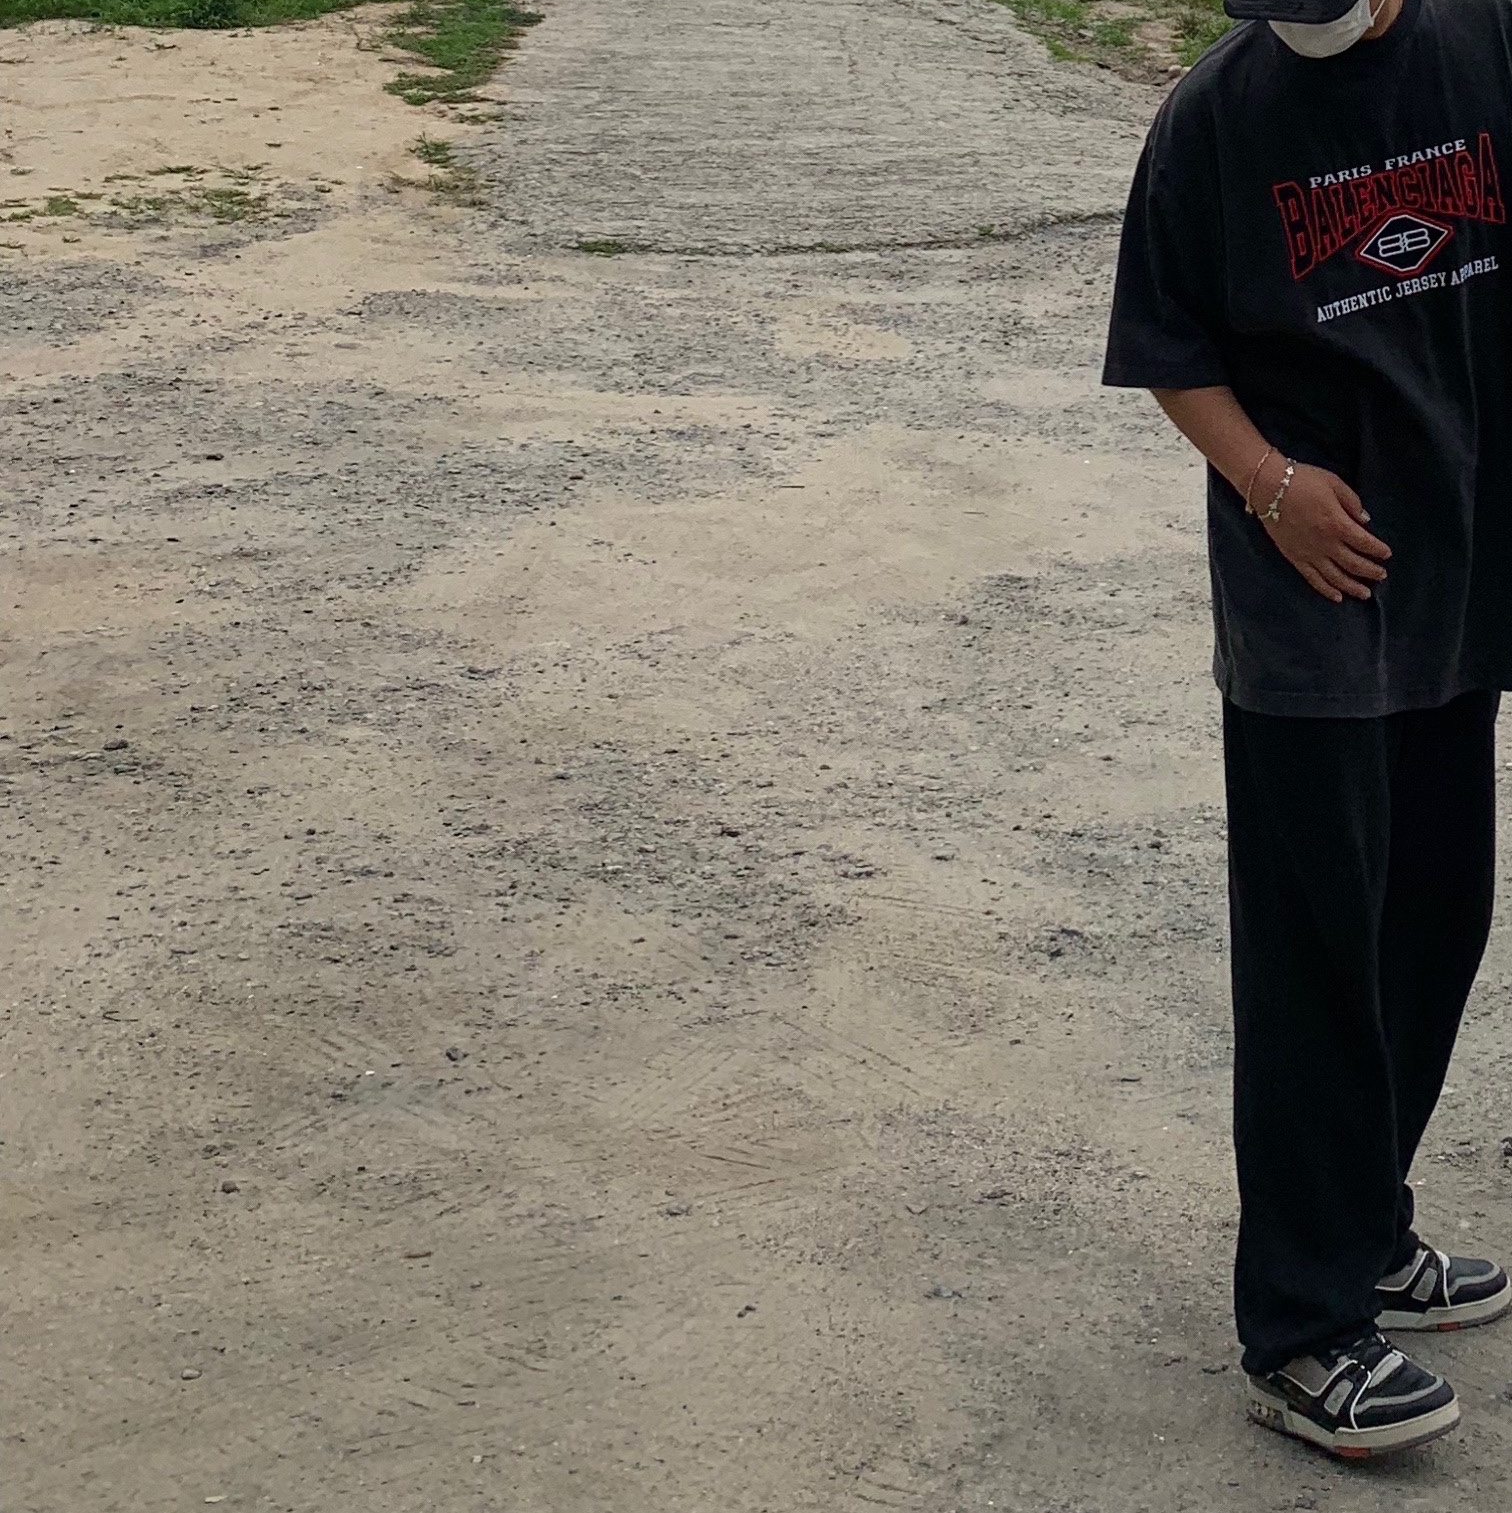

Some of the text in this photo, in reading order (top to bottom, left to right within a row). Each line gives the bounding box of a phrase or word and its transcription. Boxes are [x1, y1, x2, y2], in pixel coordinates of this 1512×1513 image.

[1309, 139, 1467, 188] PARIS FRANCE
[1272, 132, 1506, 281] BALENCIAGA
[1316, 255, 1499, 323] AUTHENTIC JERSEY APPAREL
